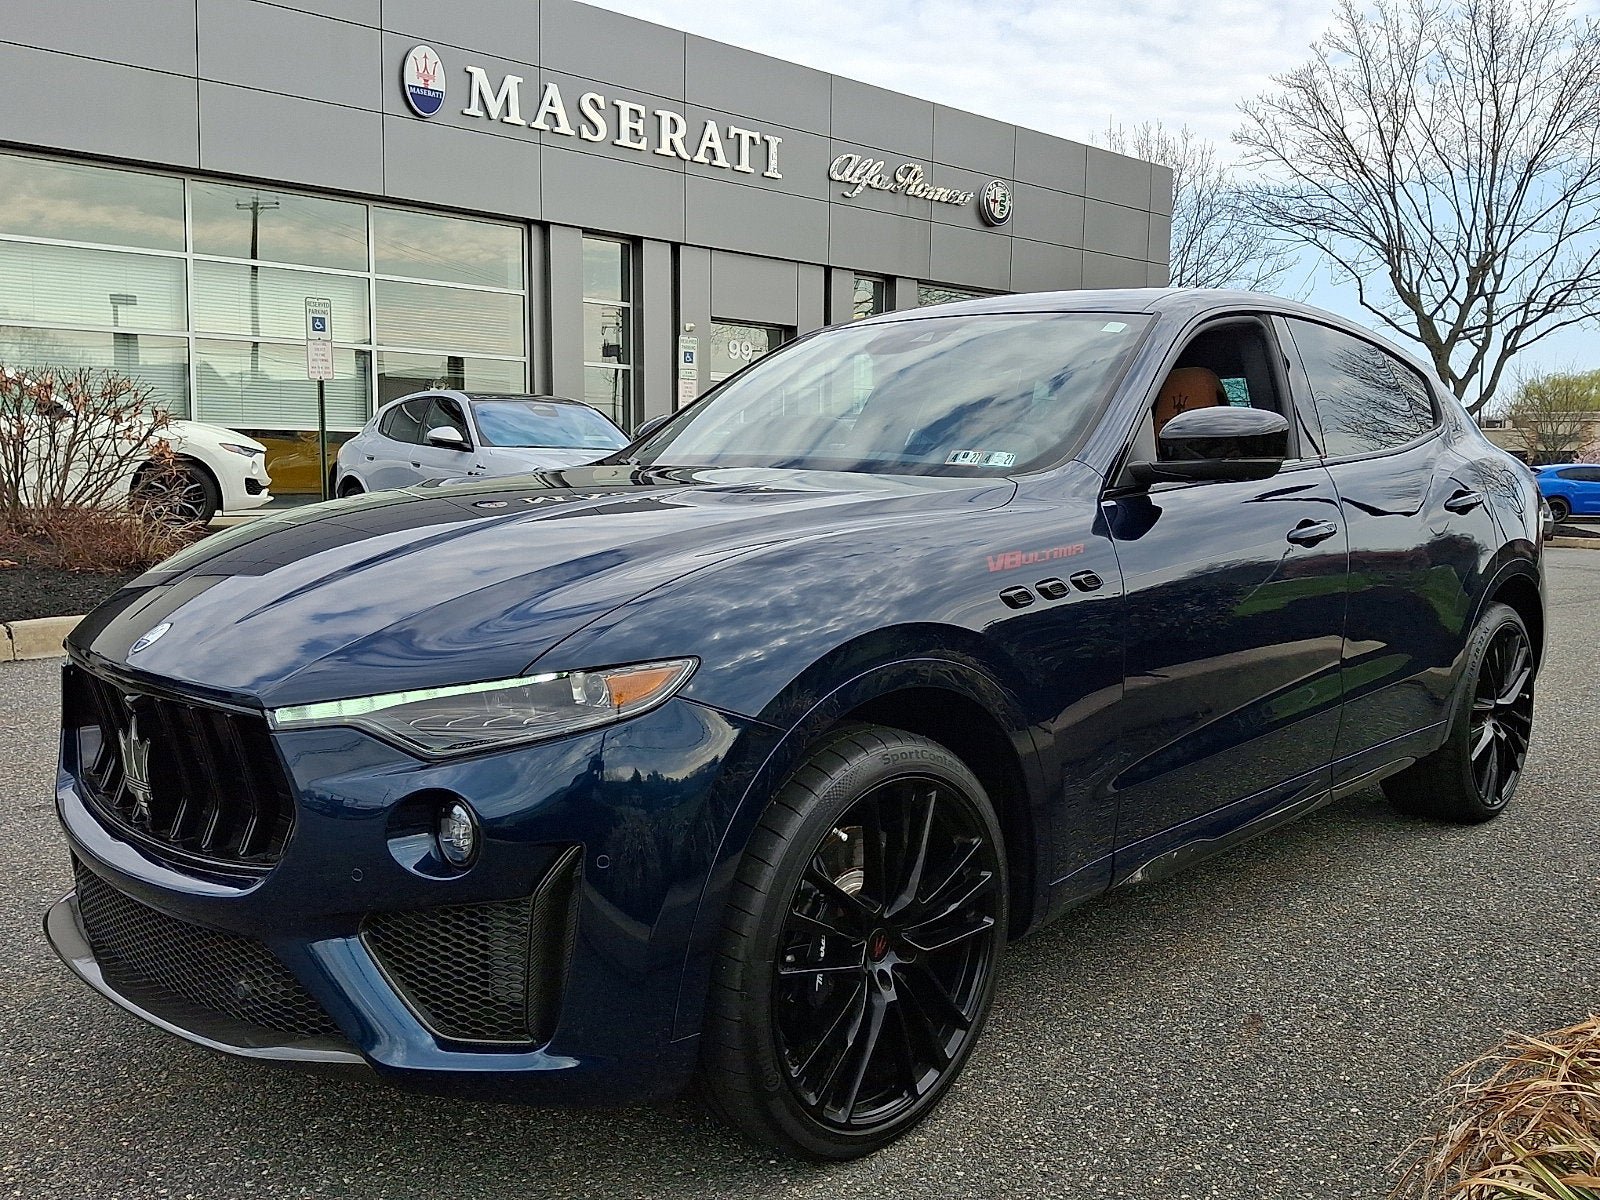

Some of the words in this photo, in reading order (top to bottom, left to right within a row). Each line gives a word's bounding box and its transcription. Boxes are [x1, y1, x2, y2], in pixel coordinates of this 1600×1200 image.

[409, 86, 442, 99] MASERATI
[462, 65, 783, 179] MASERATI
[828, 153, 892, 198] Alfa
[893, 162, 975, 206] Romeo
